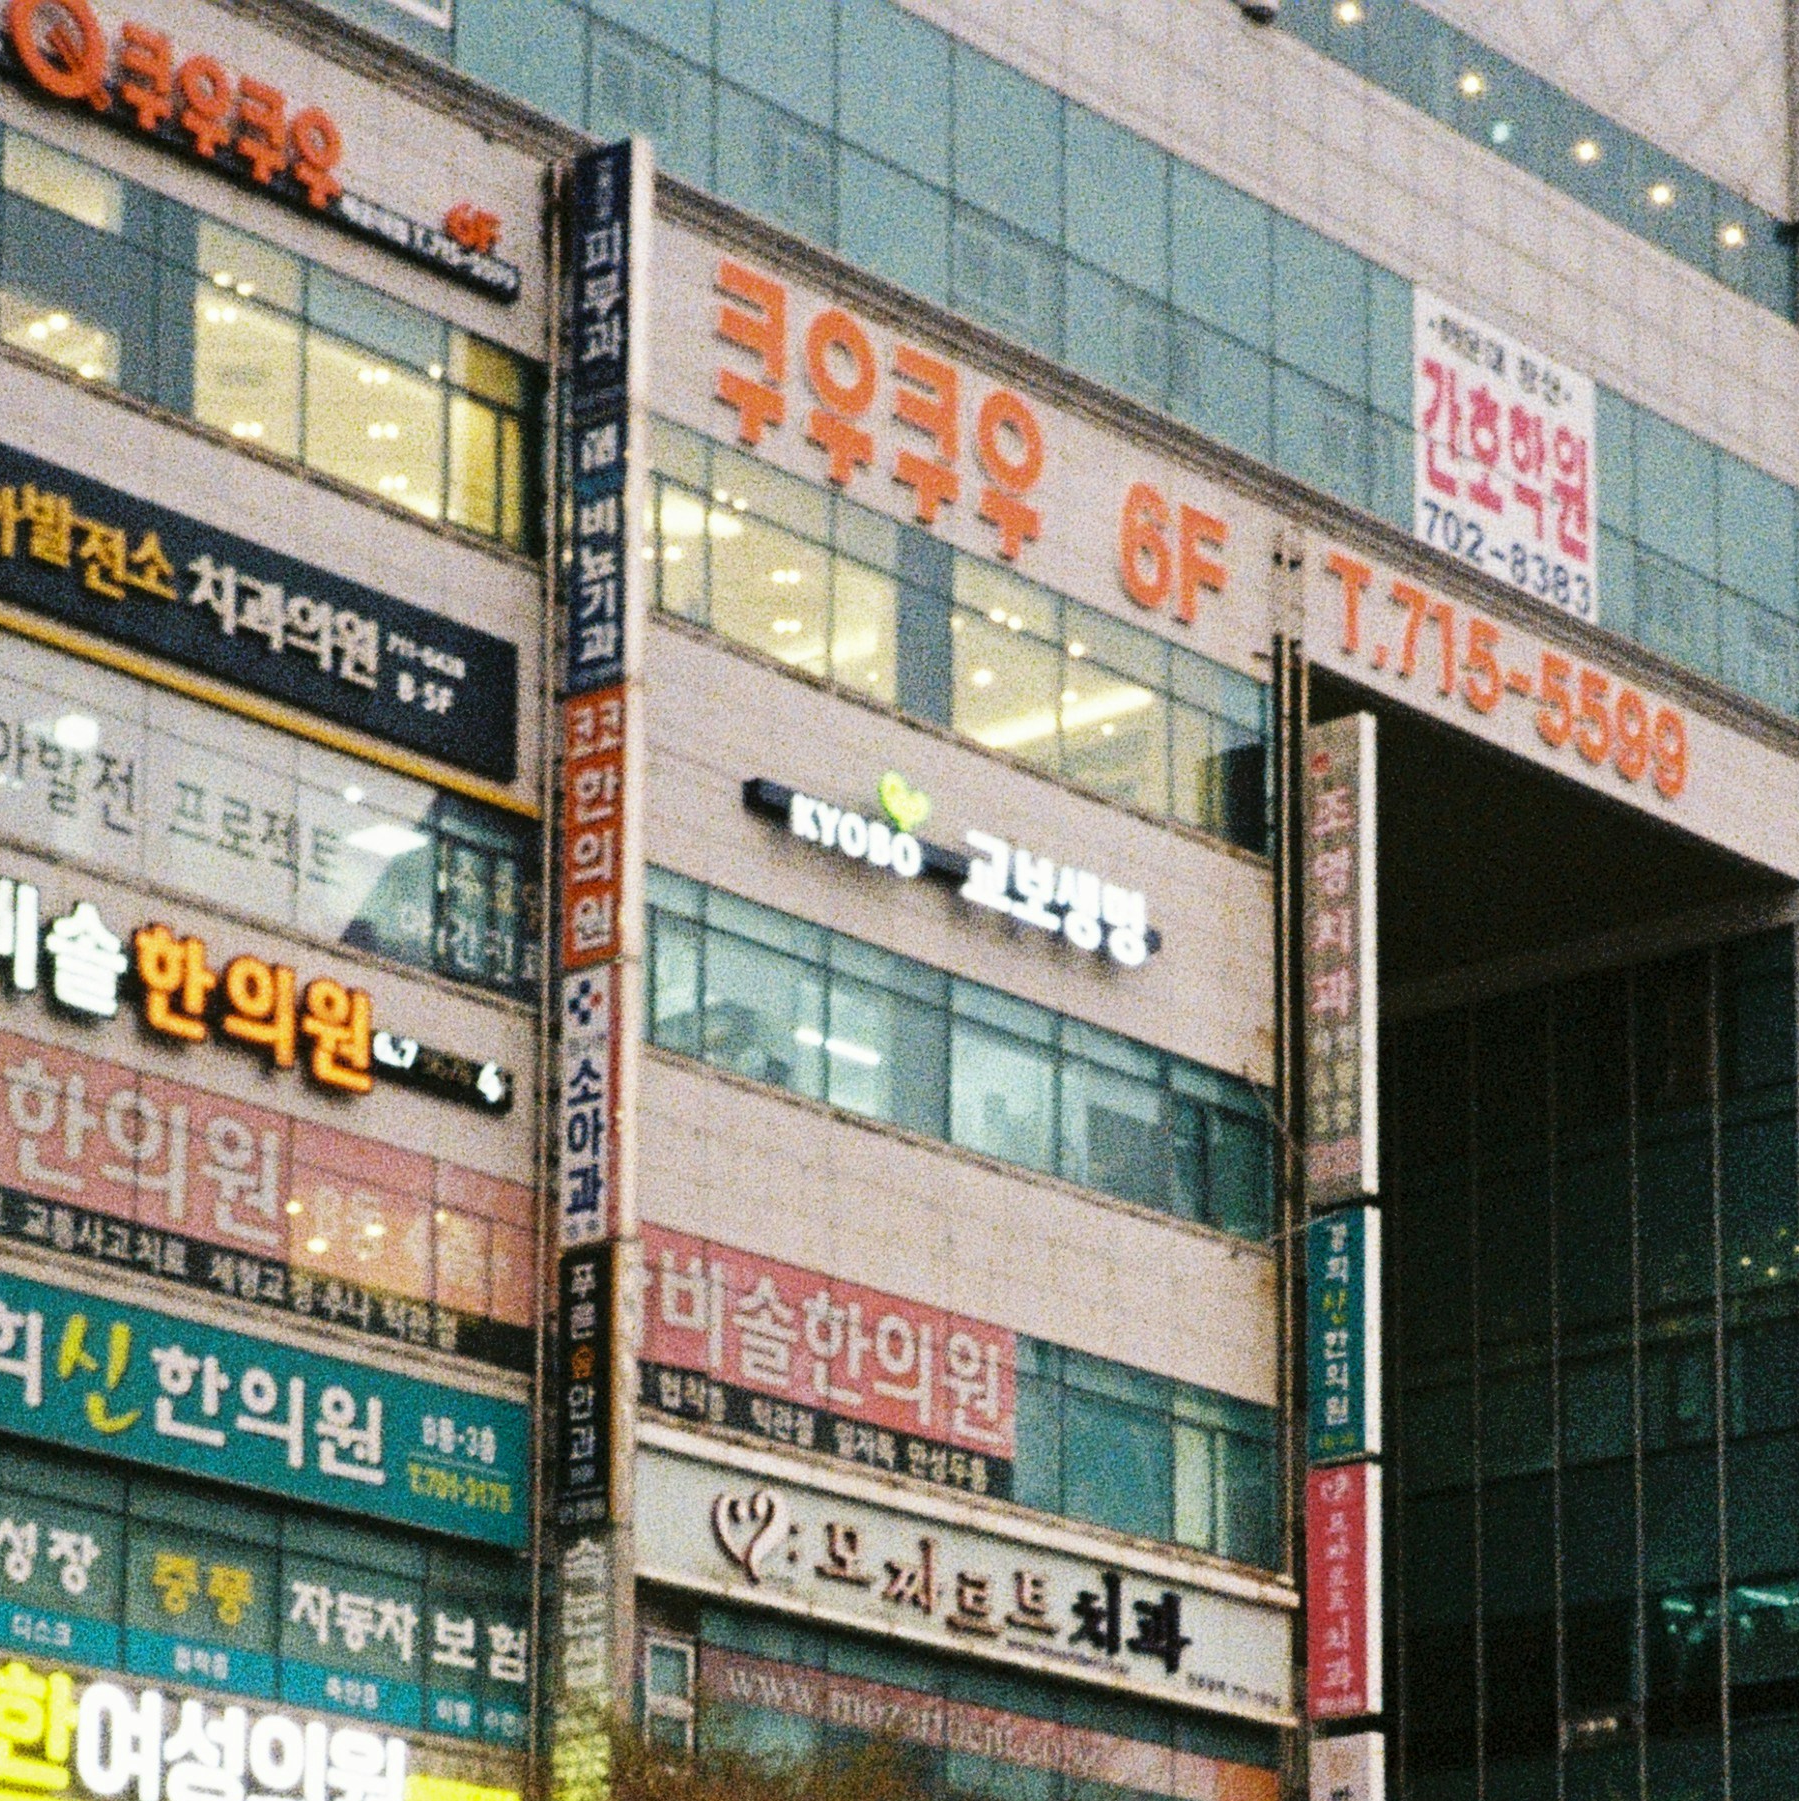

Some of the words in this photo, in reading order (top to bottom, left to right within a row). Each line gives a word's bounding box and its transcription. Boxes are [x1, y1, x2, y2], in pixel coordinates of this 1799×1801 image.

[119, 21, 344, 210] 쿠우쿠우
[715, 260, 1044, 562] 쿠우쿠우
[1120, 479, 1229, 626] 6F
[1422, 355, 1589, 563] 간호학원
[189, 552, 379, 690] 치과의원
[1422, 498, 1592, 617] 702-8383
[1326, 550, 1689, 802] T.715-5599
[790, 792, 923, 880] KYOBO
[959, 829, 1152, 970] 교보생명
[566, 1058, 605, 1215] 소아과
[635, 1243, 1003, 1446] 비솔한의원
[8, 1612, 71, 1649] 디스크
[149, 1550, 256, 1628] 중풍
[289, 1577, 420, 1665] 자동차
[432, 1609, 528, 1685] 보험
